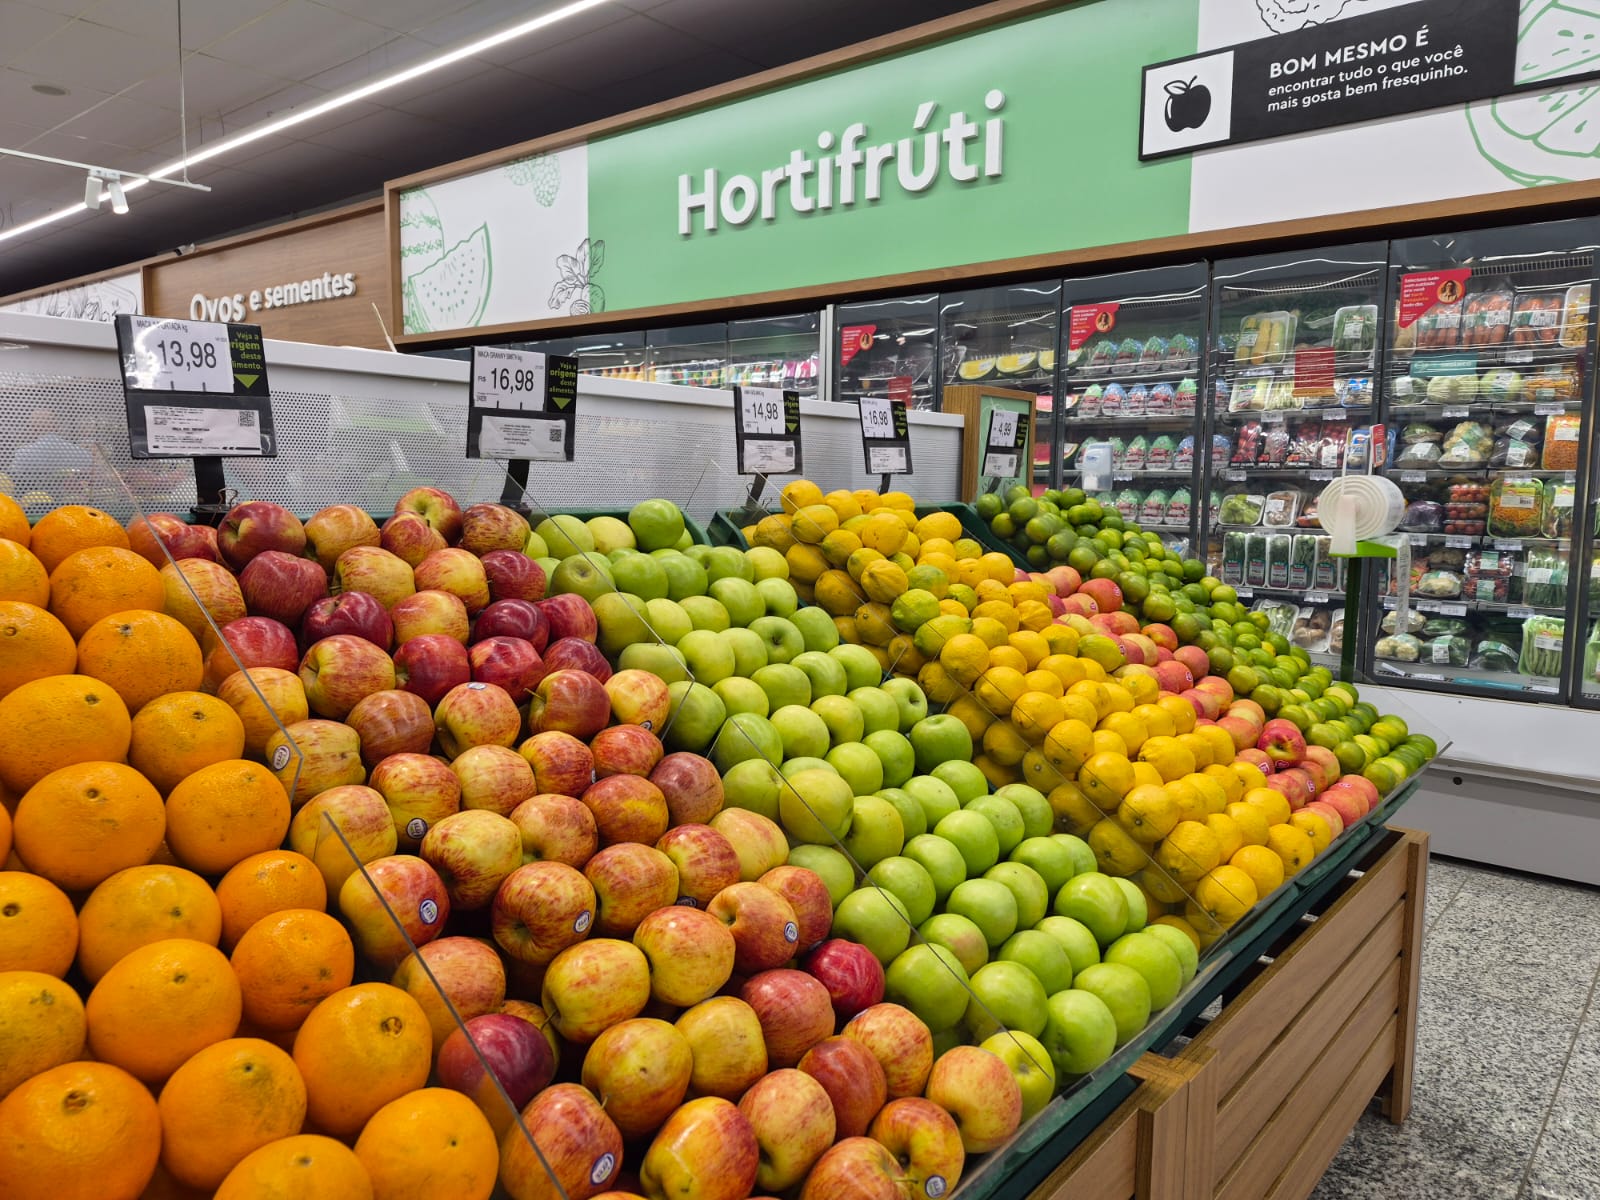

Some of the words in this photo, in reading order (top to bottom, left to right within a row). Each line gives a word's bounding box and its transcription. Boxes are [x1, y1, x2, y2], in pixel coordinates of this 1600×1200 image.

[1269, 54, 1317, 79] BOM
[1325, 34, 1407, 67] MESMO
[1415, 24, 1430, 47] É
[1268, 74, 1335, 97] encontrar
[1338, 66, 1373, 83] tudo
[1377, 64, 1387, 74] o
[1391, 56, 1421, 73] que
[1424, 44, 1464, 64] você
[1267, 95, 1298, 112] mais
[1302, 89, 1341, 108] gosta
[1345, 80, 1378, 97] bem
[1382, 64, 1468, 90] fresquinho.
[678, 89, 1005, 236] Hortifrúti
[190, 293, 247, 323] Ovos
[250, 290, 262, 311] e
[264, 271, 356, 309] sementes
[231, 339, 260, 350] rigem
[235, 331, 253, 341] Veja
[157, 339, 217, 372] 13,98
[232, 360, 263, 370] limento.
[240, 351, 262, 360] deste
[491, 367, 534, 394] 16,98
[752, 402, 778, 421] 14,98
[869, 410, 888, 427] 16,98
